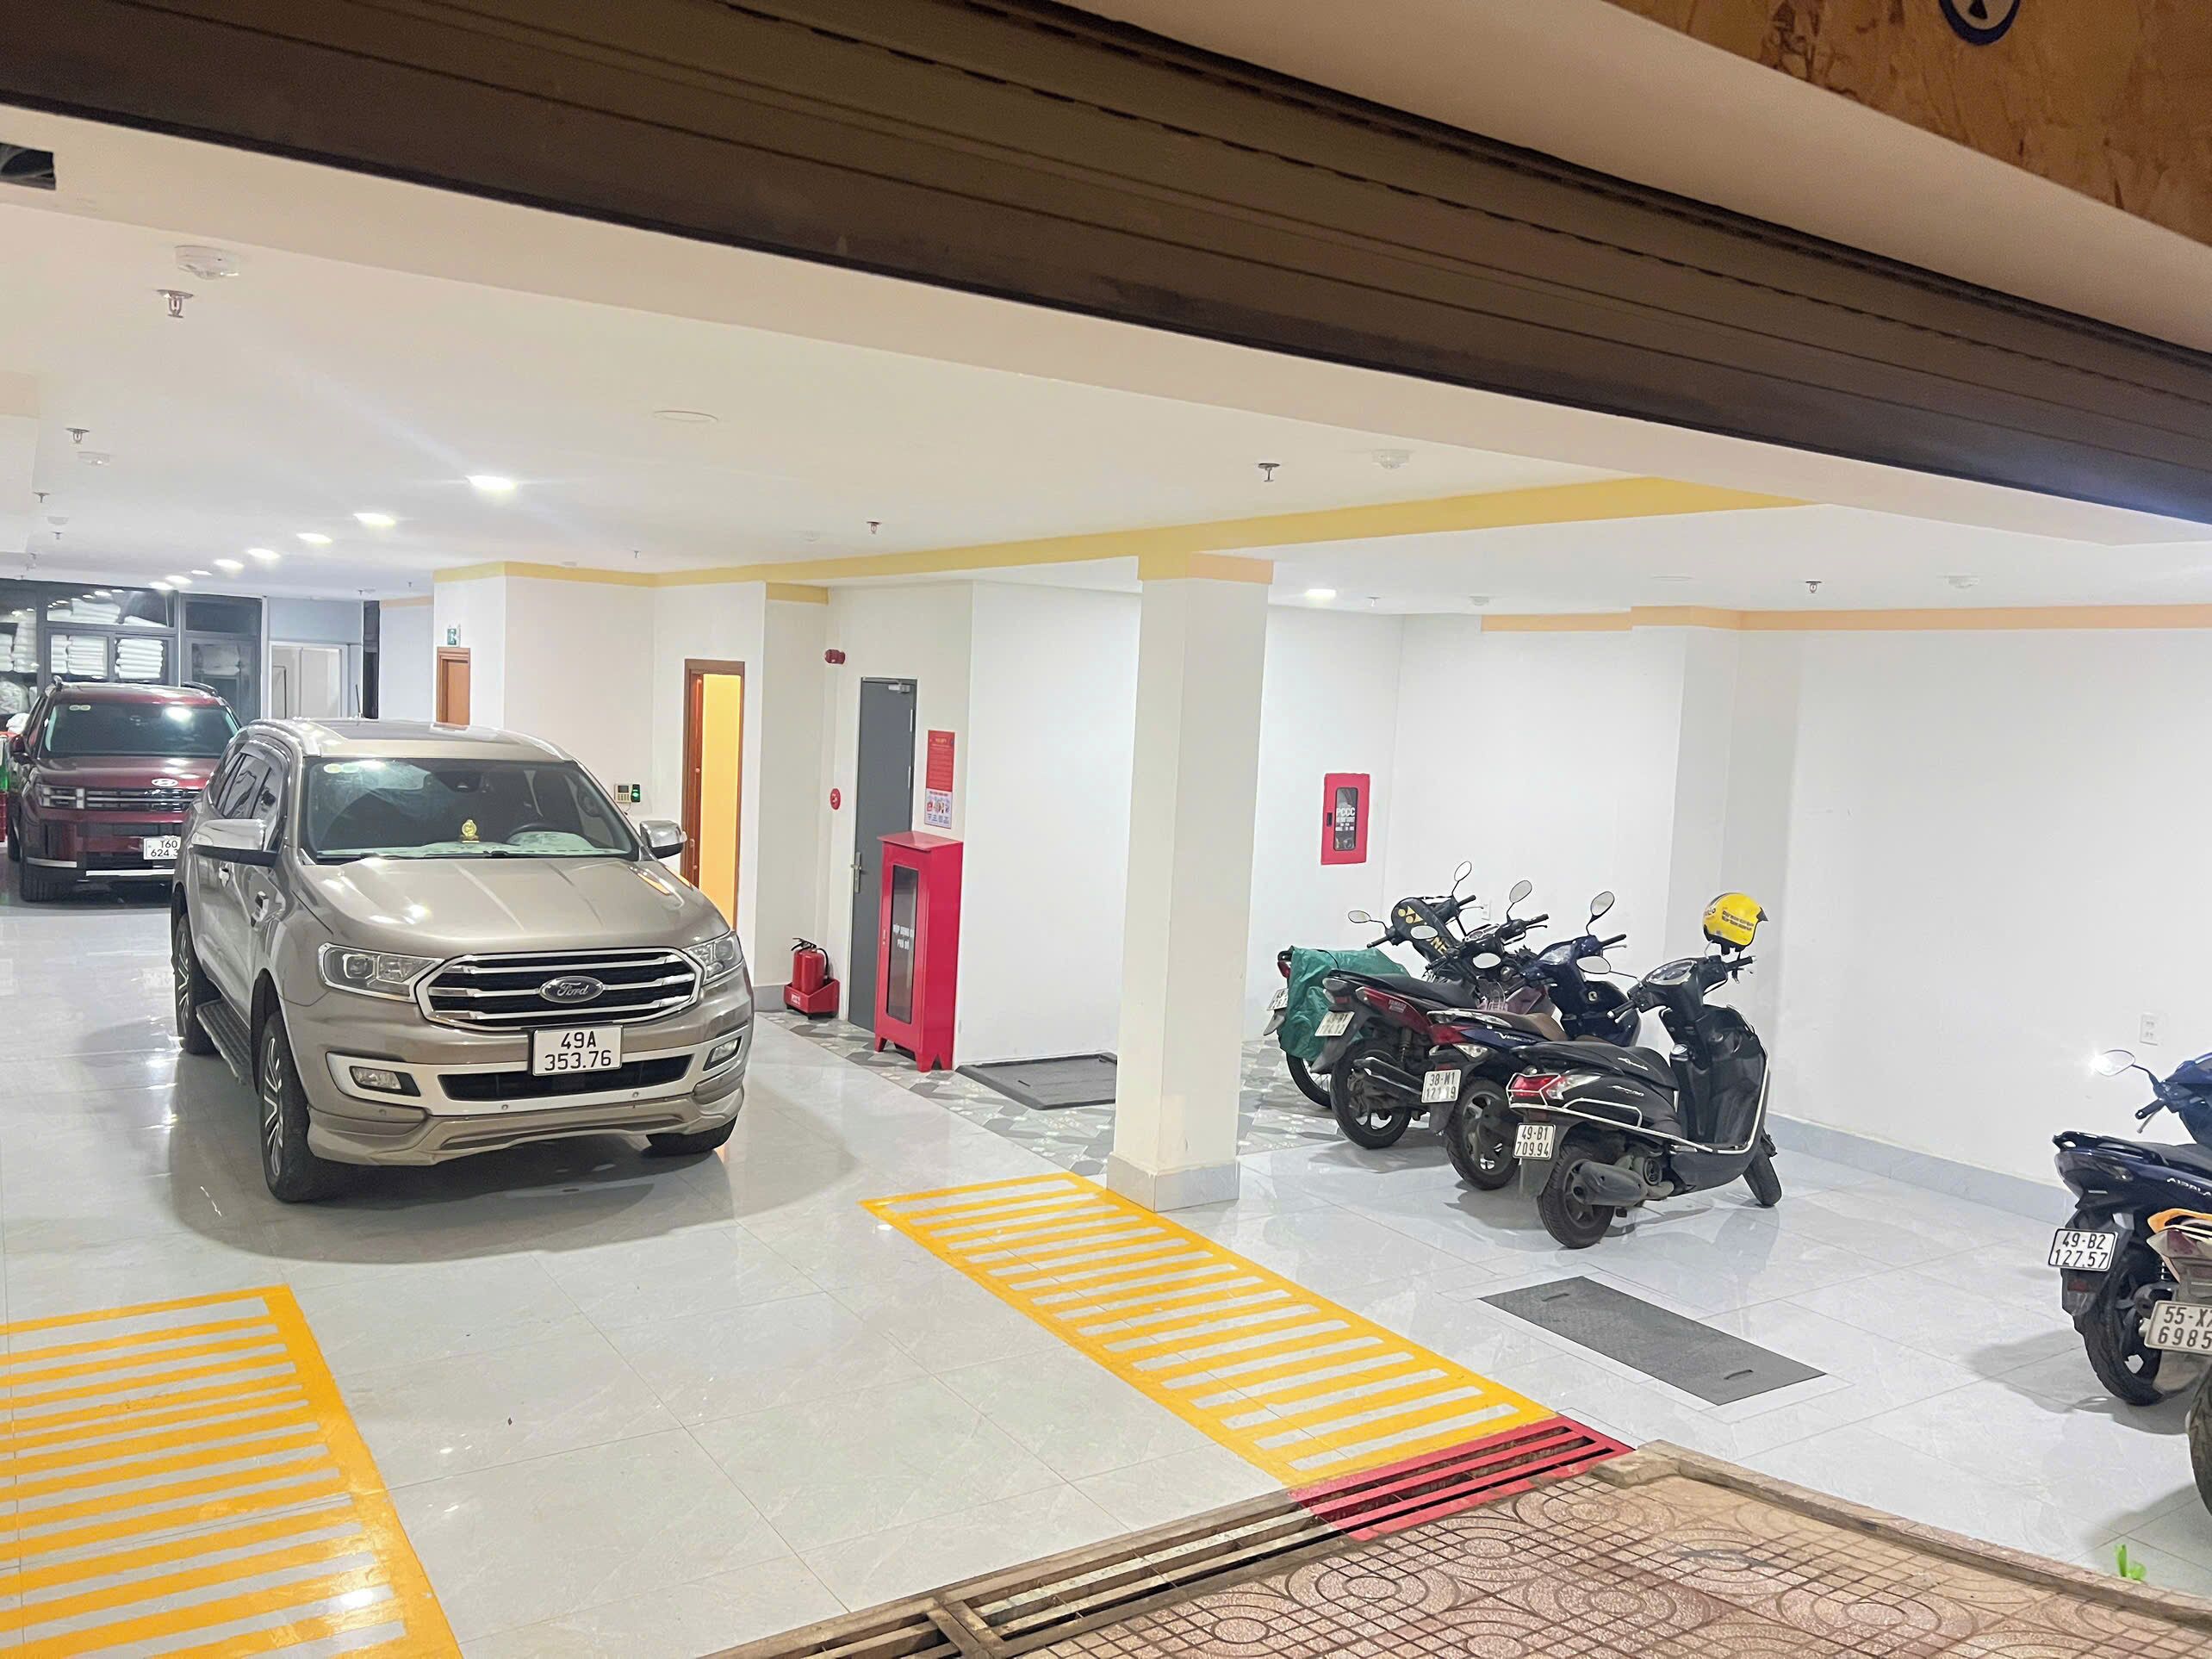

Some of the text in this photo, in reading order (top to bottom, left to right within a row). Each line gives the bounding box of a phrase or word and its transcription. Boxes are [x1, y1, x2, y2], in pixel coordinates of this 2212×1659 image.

[556, 982, 589, 997] Ford
[561, 1030, 596, 1050] 49A
[544, 1049, 612, 1071] 353.76
[1521, 1125, 1549, 1141] 49-B1
[1515, 1141, 1549, 1156] 709.94
[2062, 1232, 2106, 1250] 49-B2
[2055, 1249, 2109, 1268] 127.57
